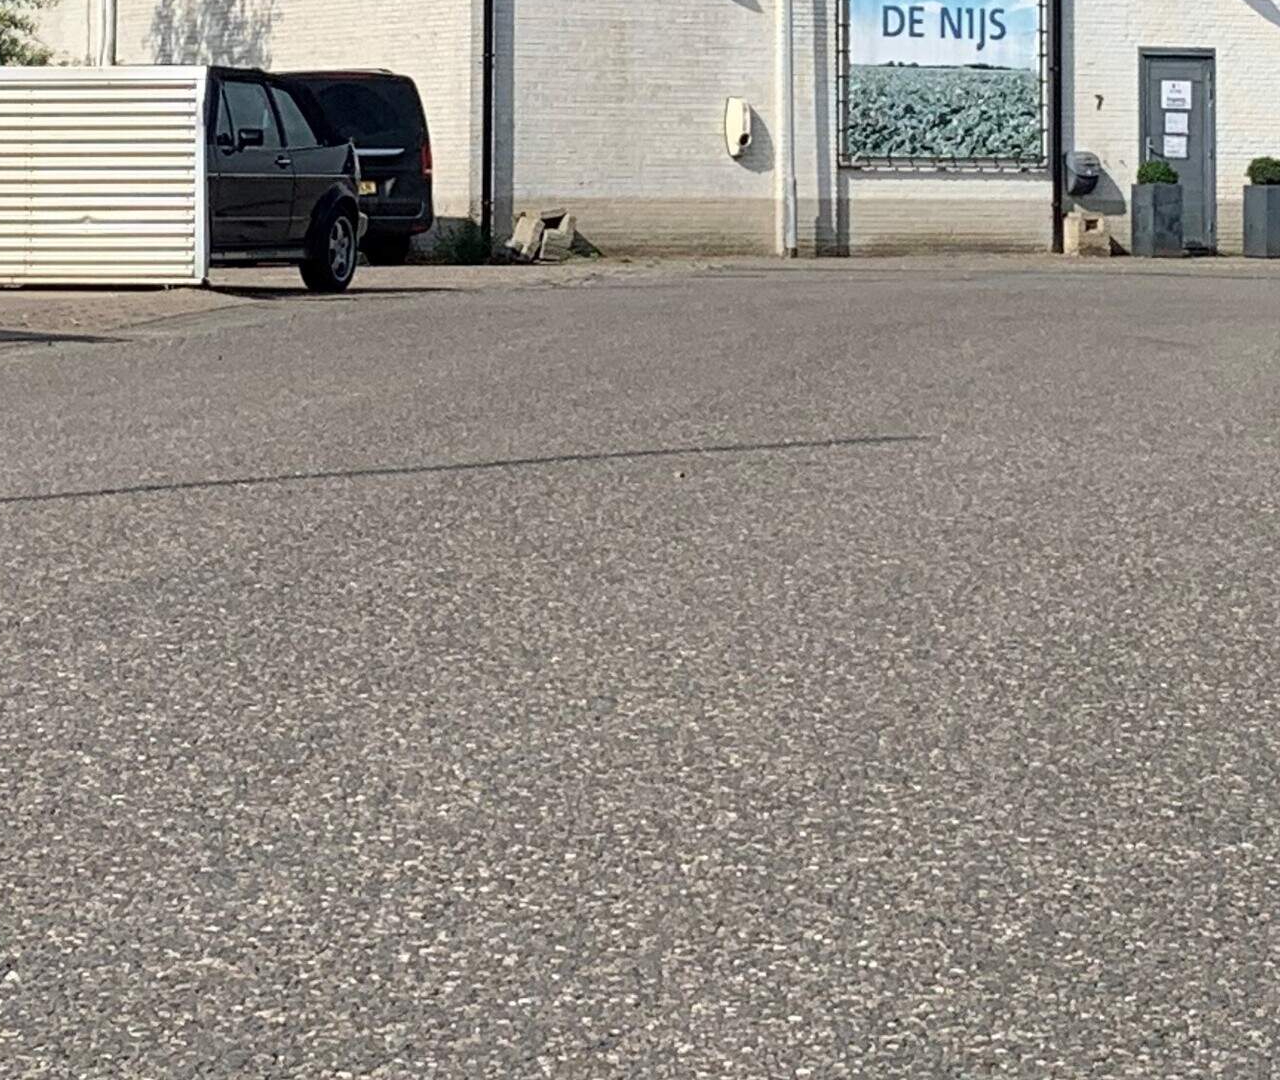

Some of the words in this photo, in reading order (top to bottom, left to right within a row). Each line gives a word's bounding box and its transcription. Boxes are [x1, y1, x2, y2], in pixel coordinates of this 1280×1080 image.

[882, 5, 925, 38] DE
[940, 6, 1007, 52] NIJS
[1094, 94, 1104, 111] 7
